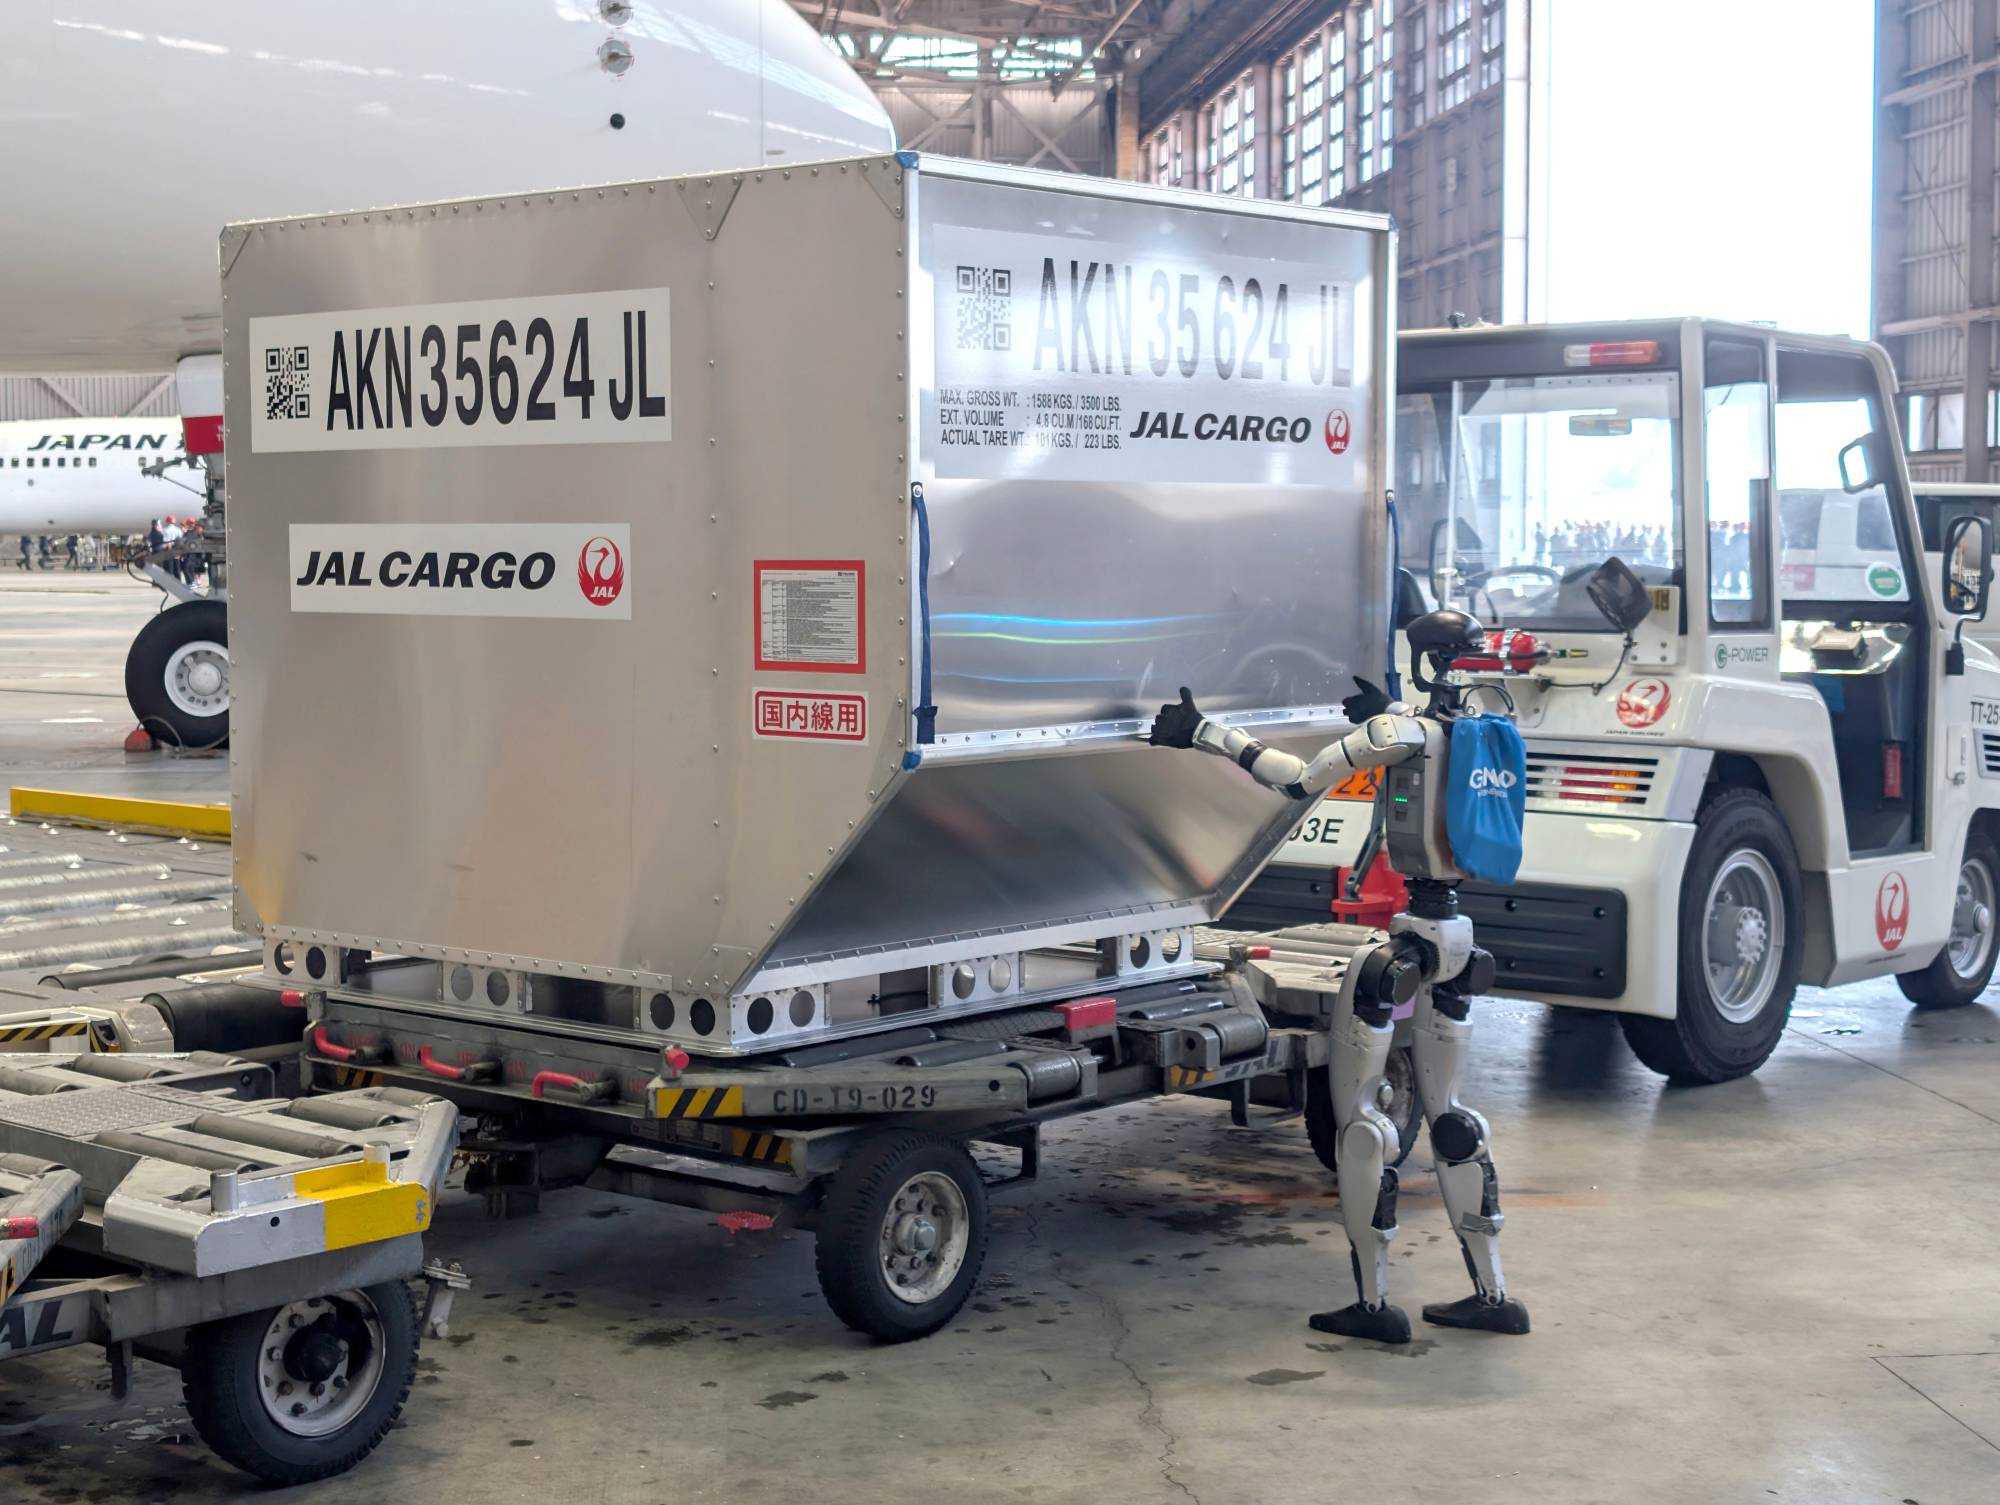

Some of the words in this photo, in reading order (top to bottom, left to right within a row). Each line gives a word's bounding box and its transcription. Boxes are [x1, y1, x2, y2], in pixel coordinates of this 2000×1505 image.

[1033, 257, 1132, 376] AKN
[1308, 284, 1351, 388] JL
[608, 310, 666, 421] JL
[940, 389, 964, 405] MAX.
[967, 390, 1000, 407] GROSS
[1003, 391, 1020, 408] WT.
[1081, 395, 1100, 411] 3500
[1102, 396, 1122, 412] LBS.
[940, 408, 961, 425] EXT.
[964, 410, 1004, 426] VOLUME
[1129, 411, 1189, 439] JAL
[1194, 413, 1312, 443] CARGO
[27, 434, 168, 451] JAPAN
[941, 429, 980, 445] ACTUAL
[982, 430, 1008, 446] TARE
[1084, 433, 1100, 449] 223
[1101, 434, 1122, 450] LBS.
[296, 551, 372, 587] JAL
[378, 550, 556, 590] CARGO
[589, 585, 616, 598] JAL
[762, 699, 859, 733] 国内線用
[1469, 766, 1517, 789] GMO
[1883, 927, 1902, 943] JAL
